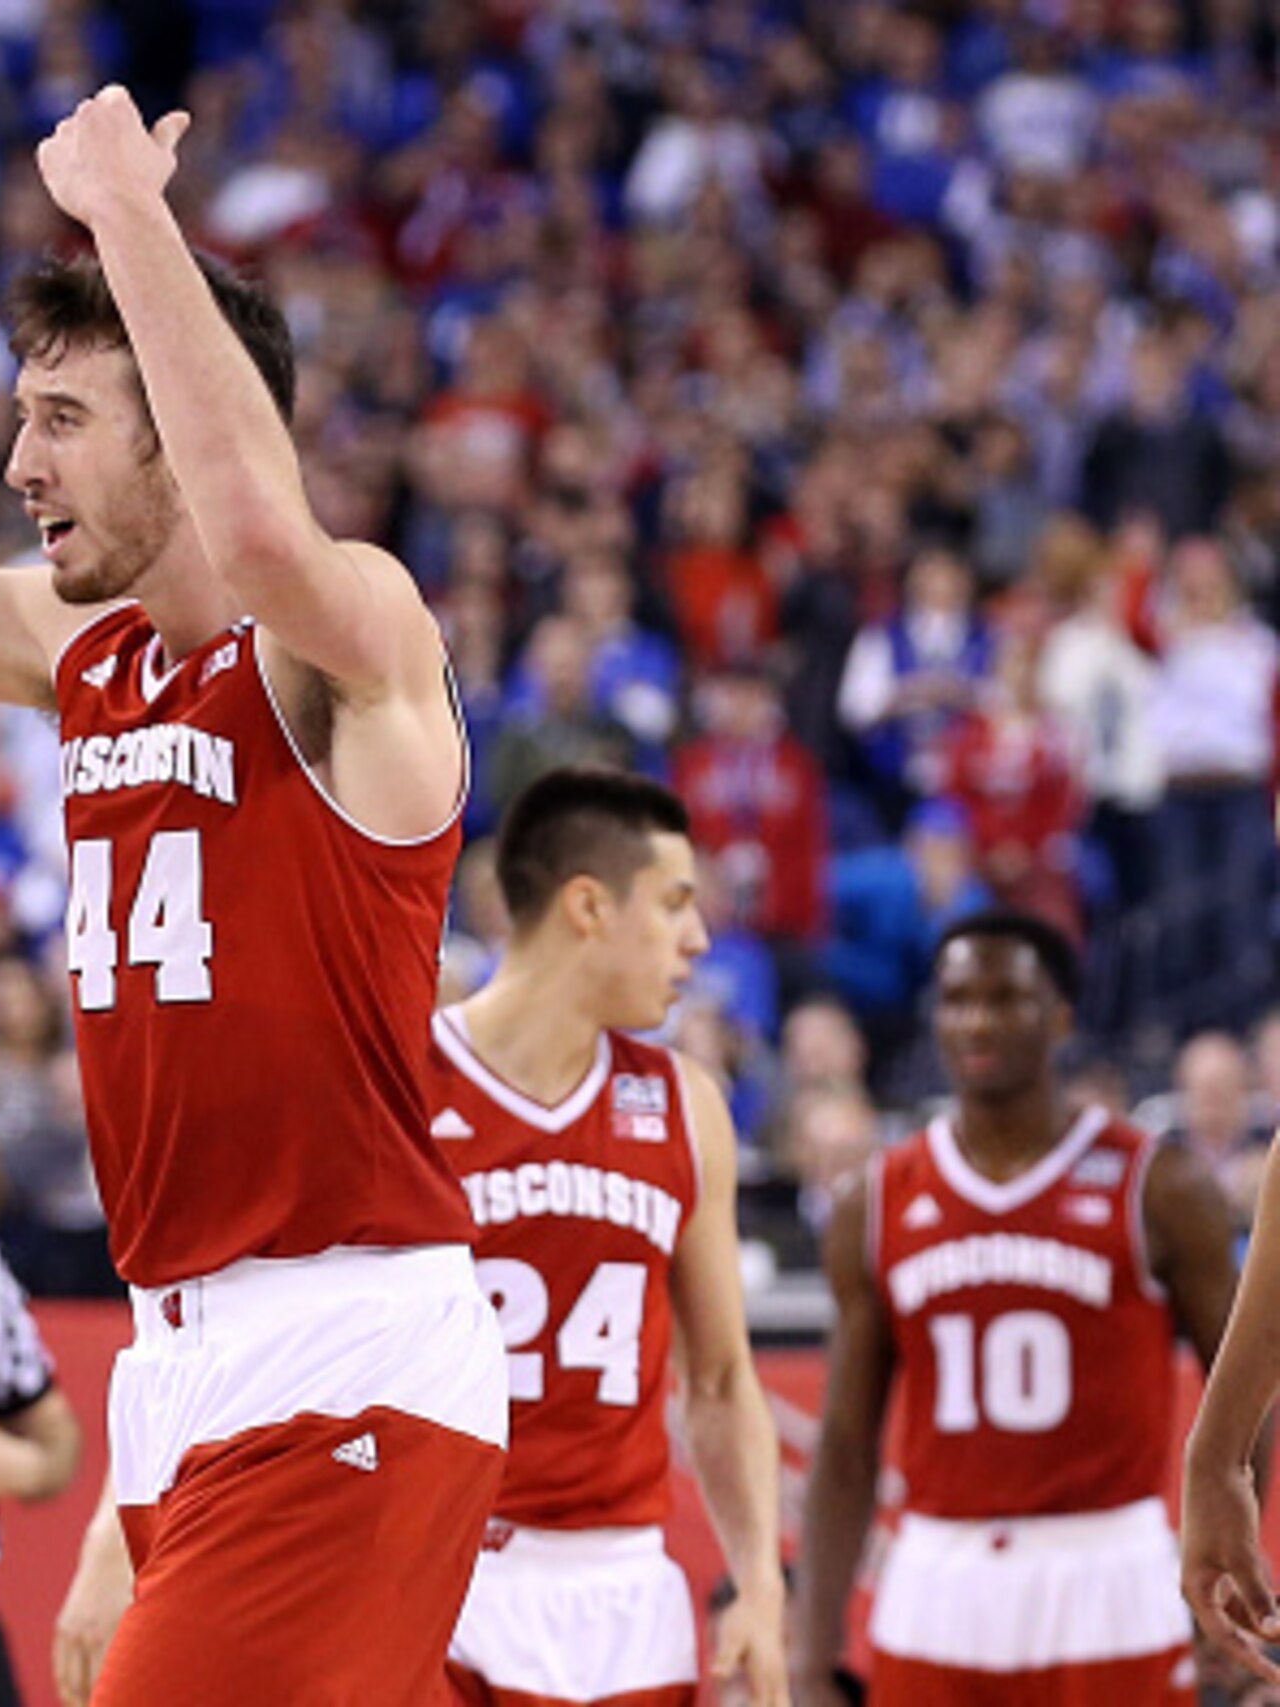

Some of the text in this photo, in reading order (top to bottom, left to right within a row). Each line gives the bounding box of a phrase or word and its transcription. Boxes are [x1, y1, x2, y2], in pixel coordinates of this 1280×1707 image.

[60, 723, 237, 805] ISCONSIN
[67, 829, 213, 1010] 44
[460, 1160, 682, 1256] ISCONSIN
[474, 1257, 648, 1406] 24
[928, 1309, 1072, 1434] 10
